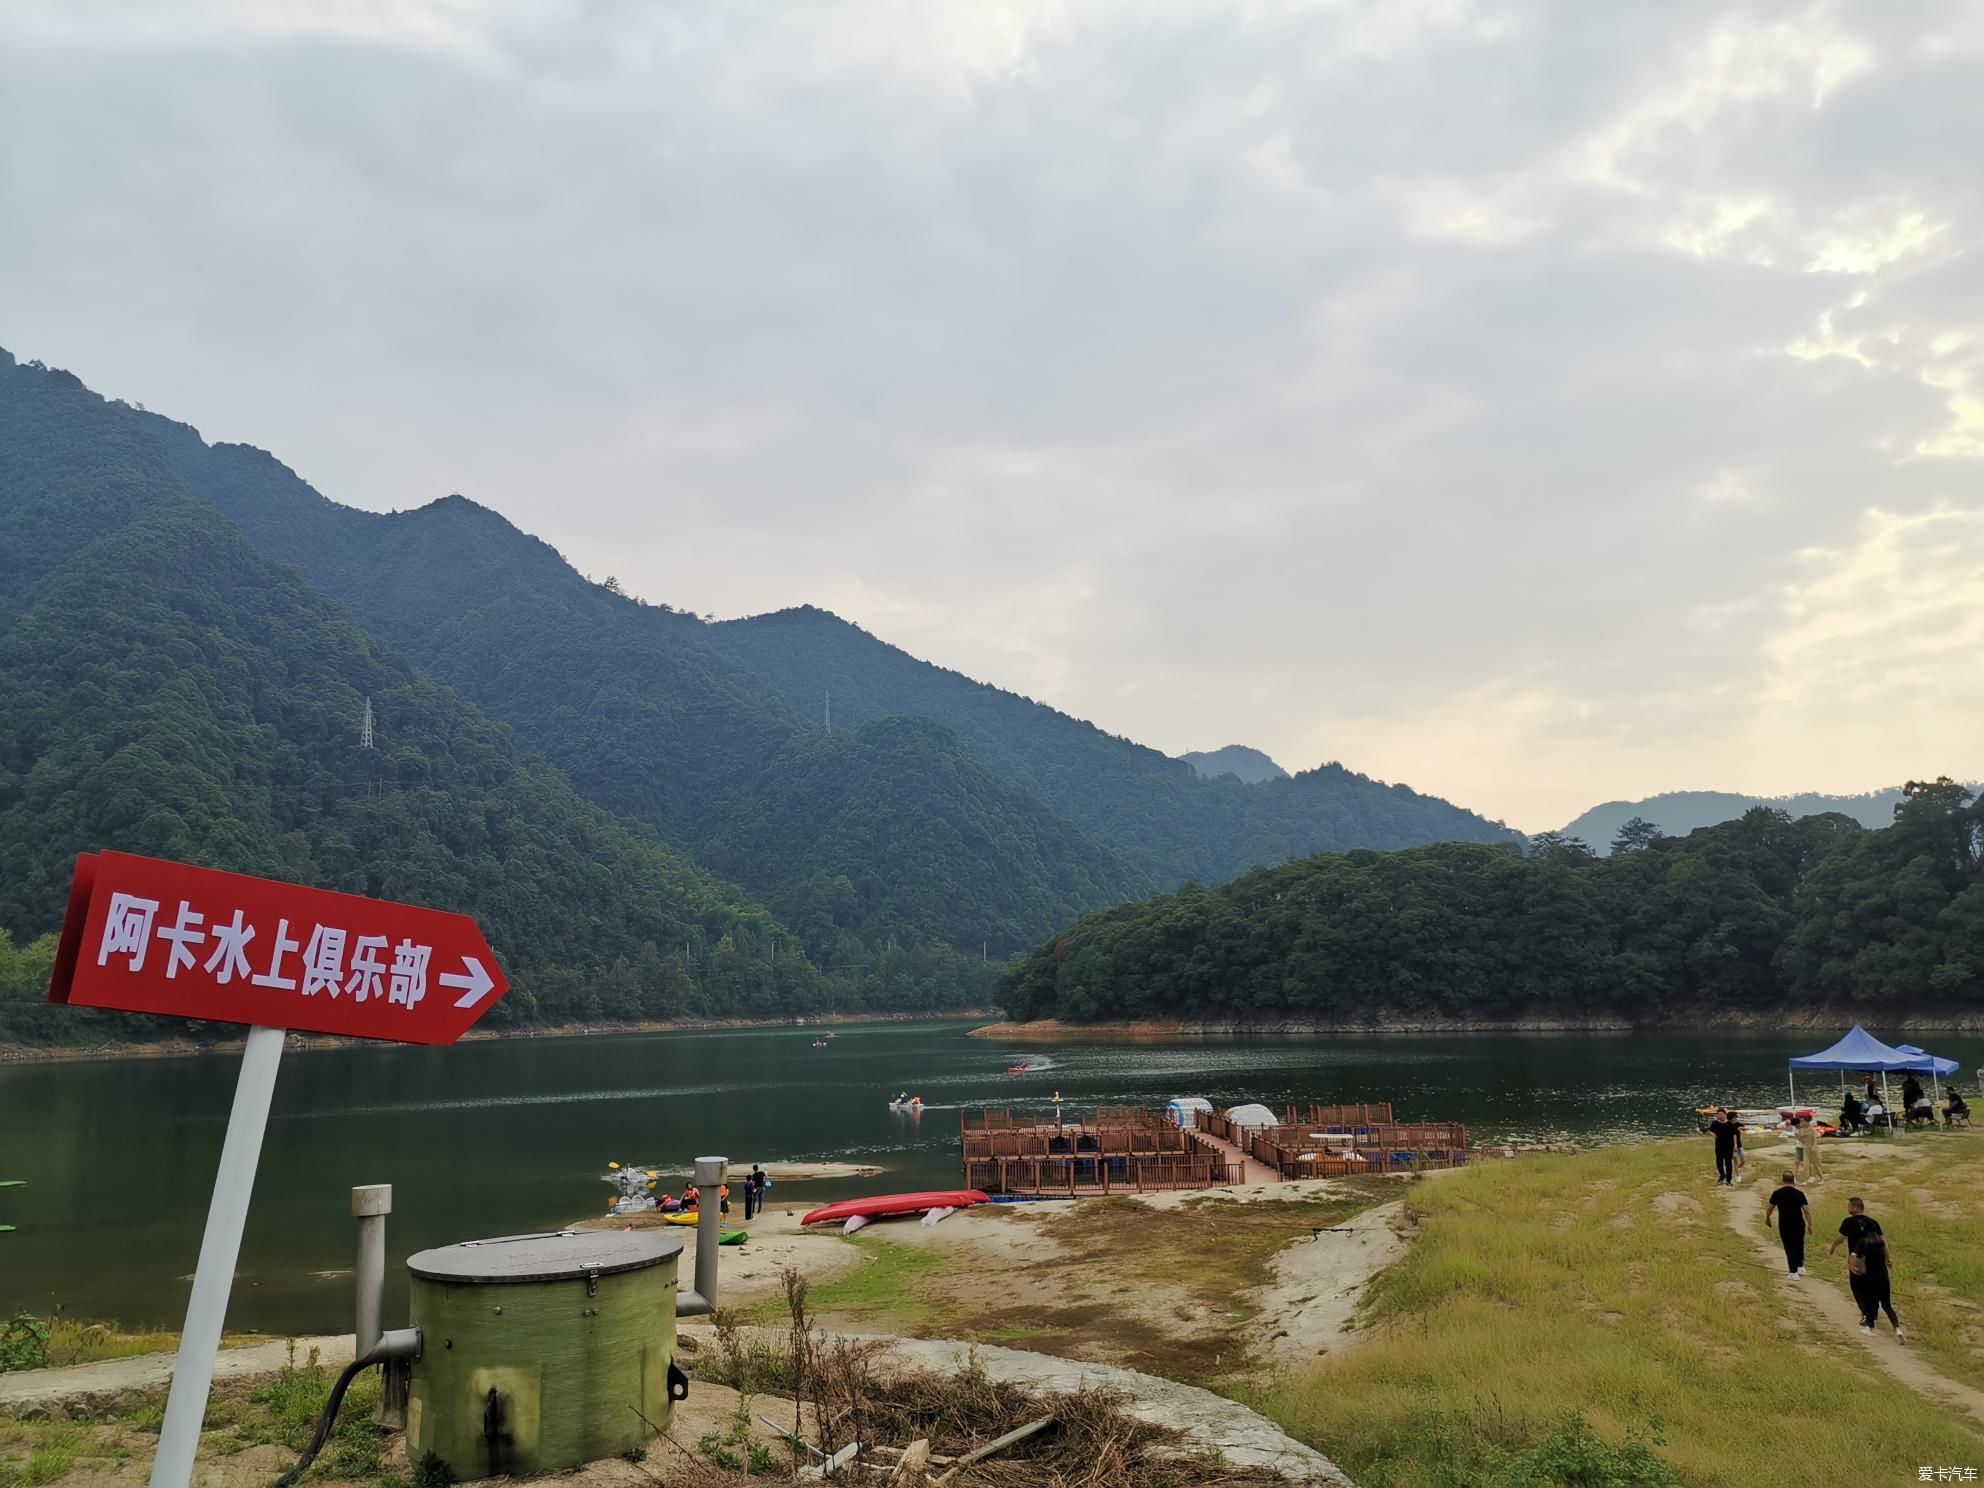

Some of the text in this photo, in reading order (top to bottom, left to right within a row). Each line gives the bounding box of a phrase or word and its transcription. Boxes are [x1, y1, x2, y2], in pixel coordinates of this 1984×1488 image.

[97, 892, 433, 1010] 阿卡水上俱乐部
